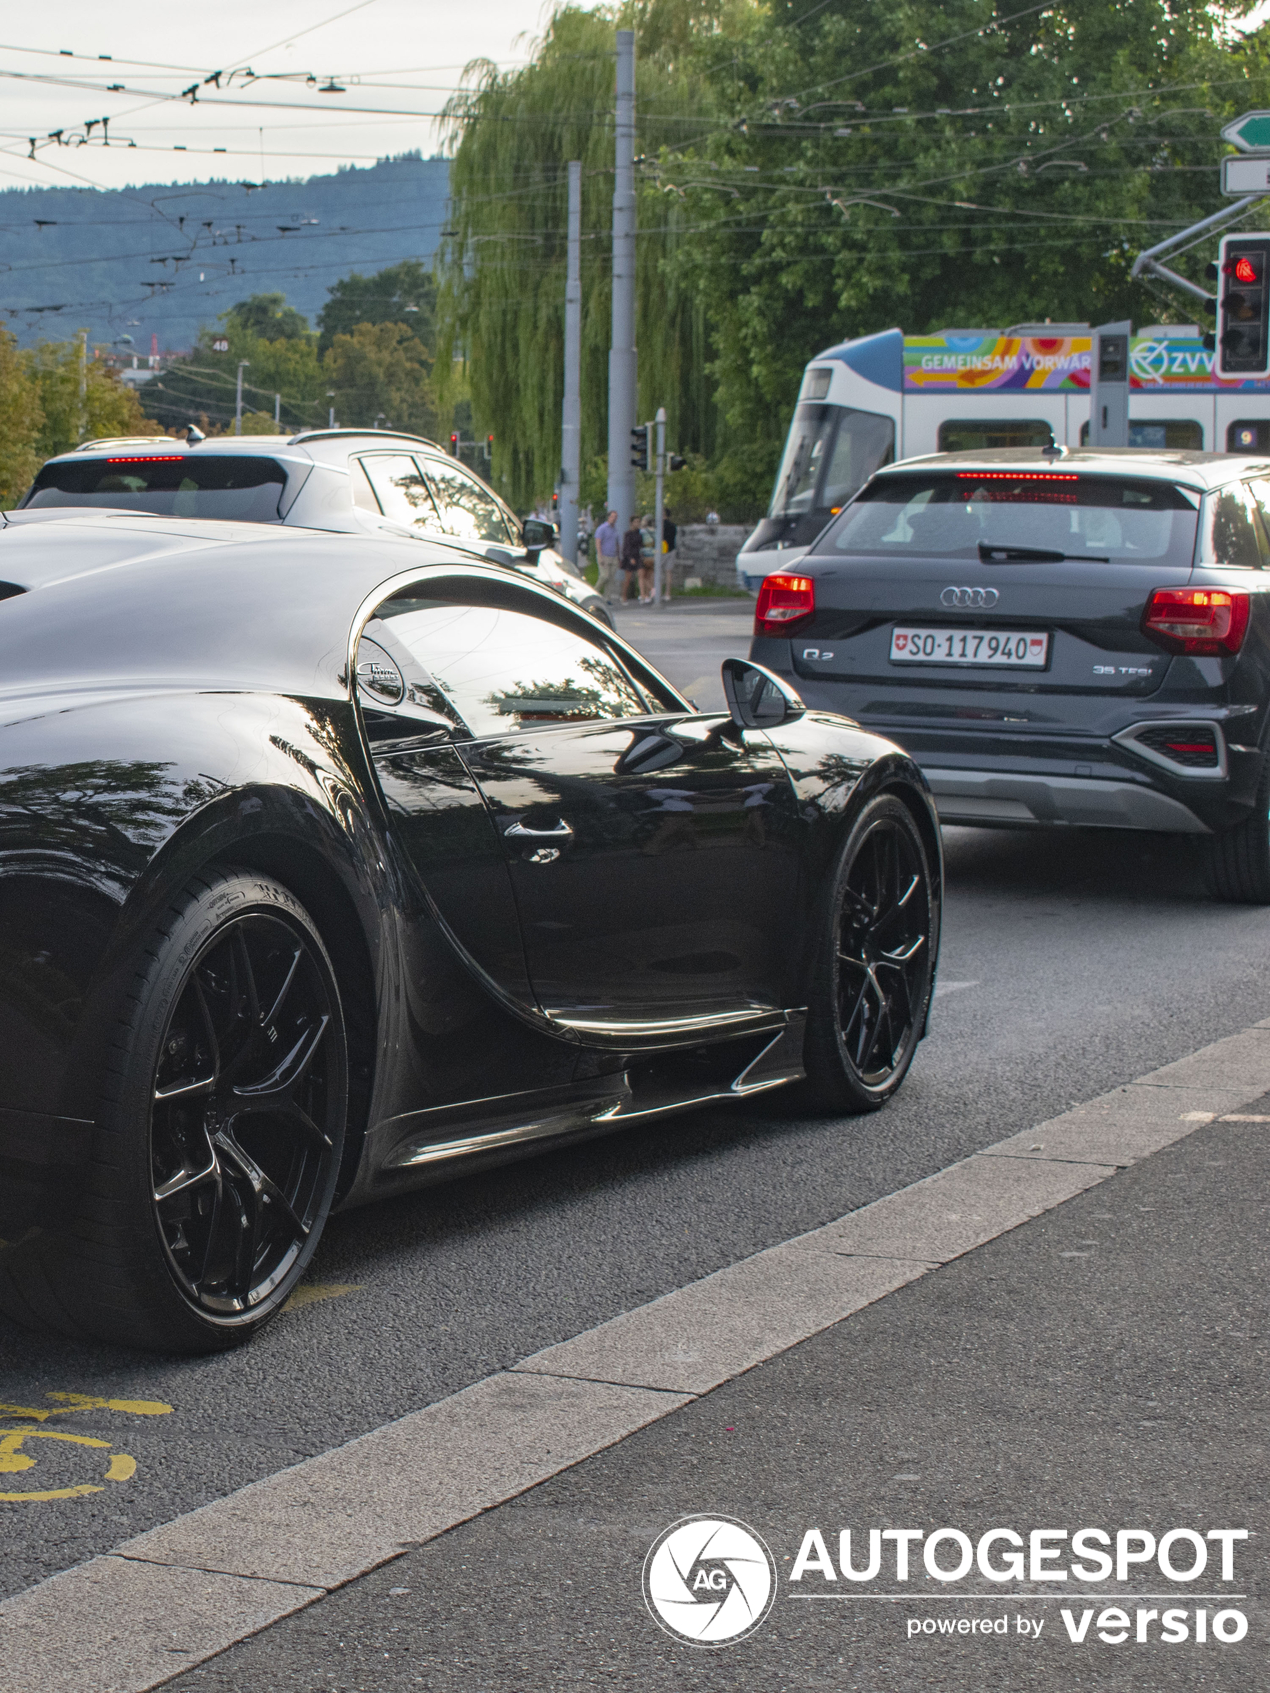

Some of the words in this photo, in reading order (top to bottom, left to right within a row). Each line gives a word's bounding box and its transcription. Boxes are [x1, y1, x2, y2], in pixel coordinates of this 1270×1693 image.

[921, 354, 1018, 370] GEMEINSAM
[1170, 352, 1217, 373] ZVV
[1241, 430, 1253, 445] 9
[803, 648, 834, 661] Q2
[1092, 665, 1116, 675] 35
